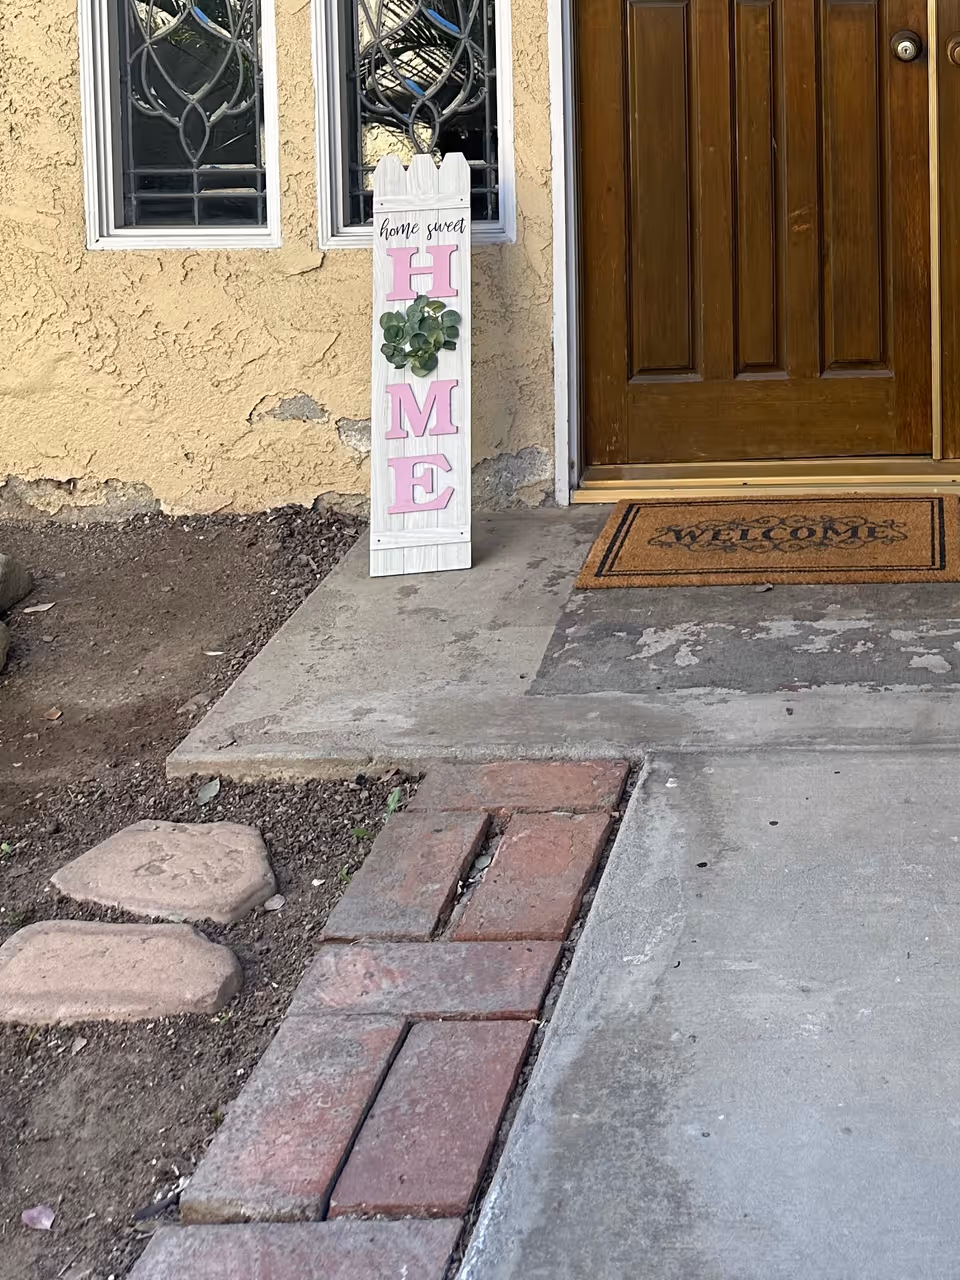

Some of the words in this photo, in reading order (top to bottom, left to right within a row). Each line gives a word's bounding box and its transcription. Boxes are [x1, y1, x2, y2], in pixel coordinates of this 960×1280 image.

[380, 218, 420, 240] home
[426, 217, 466, 240] sweet
[671, 525, 888, 542] WELCOME
